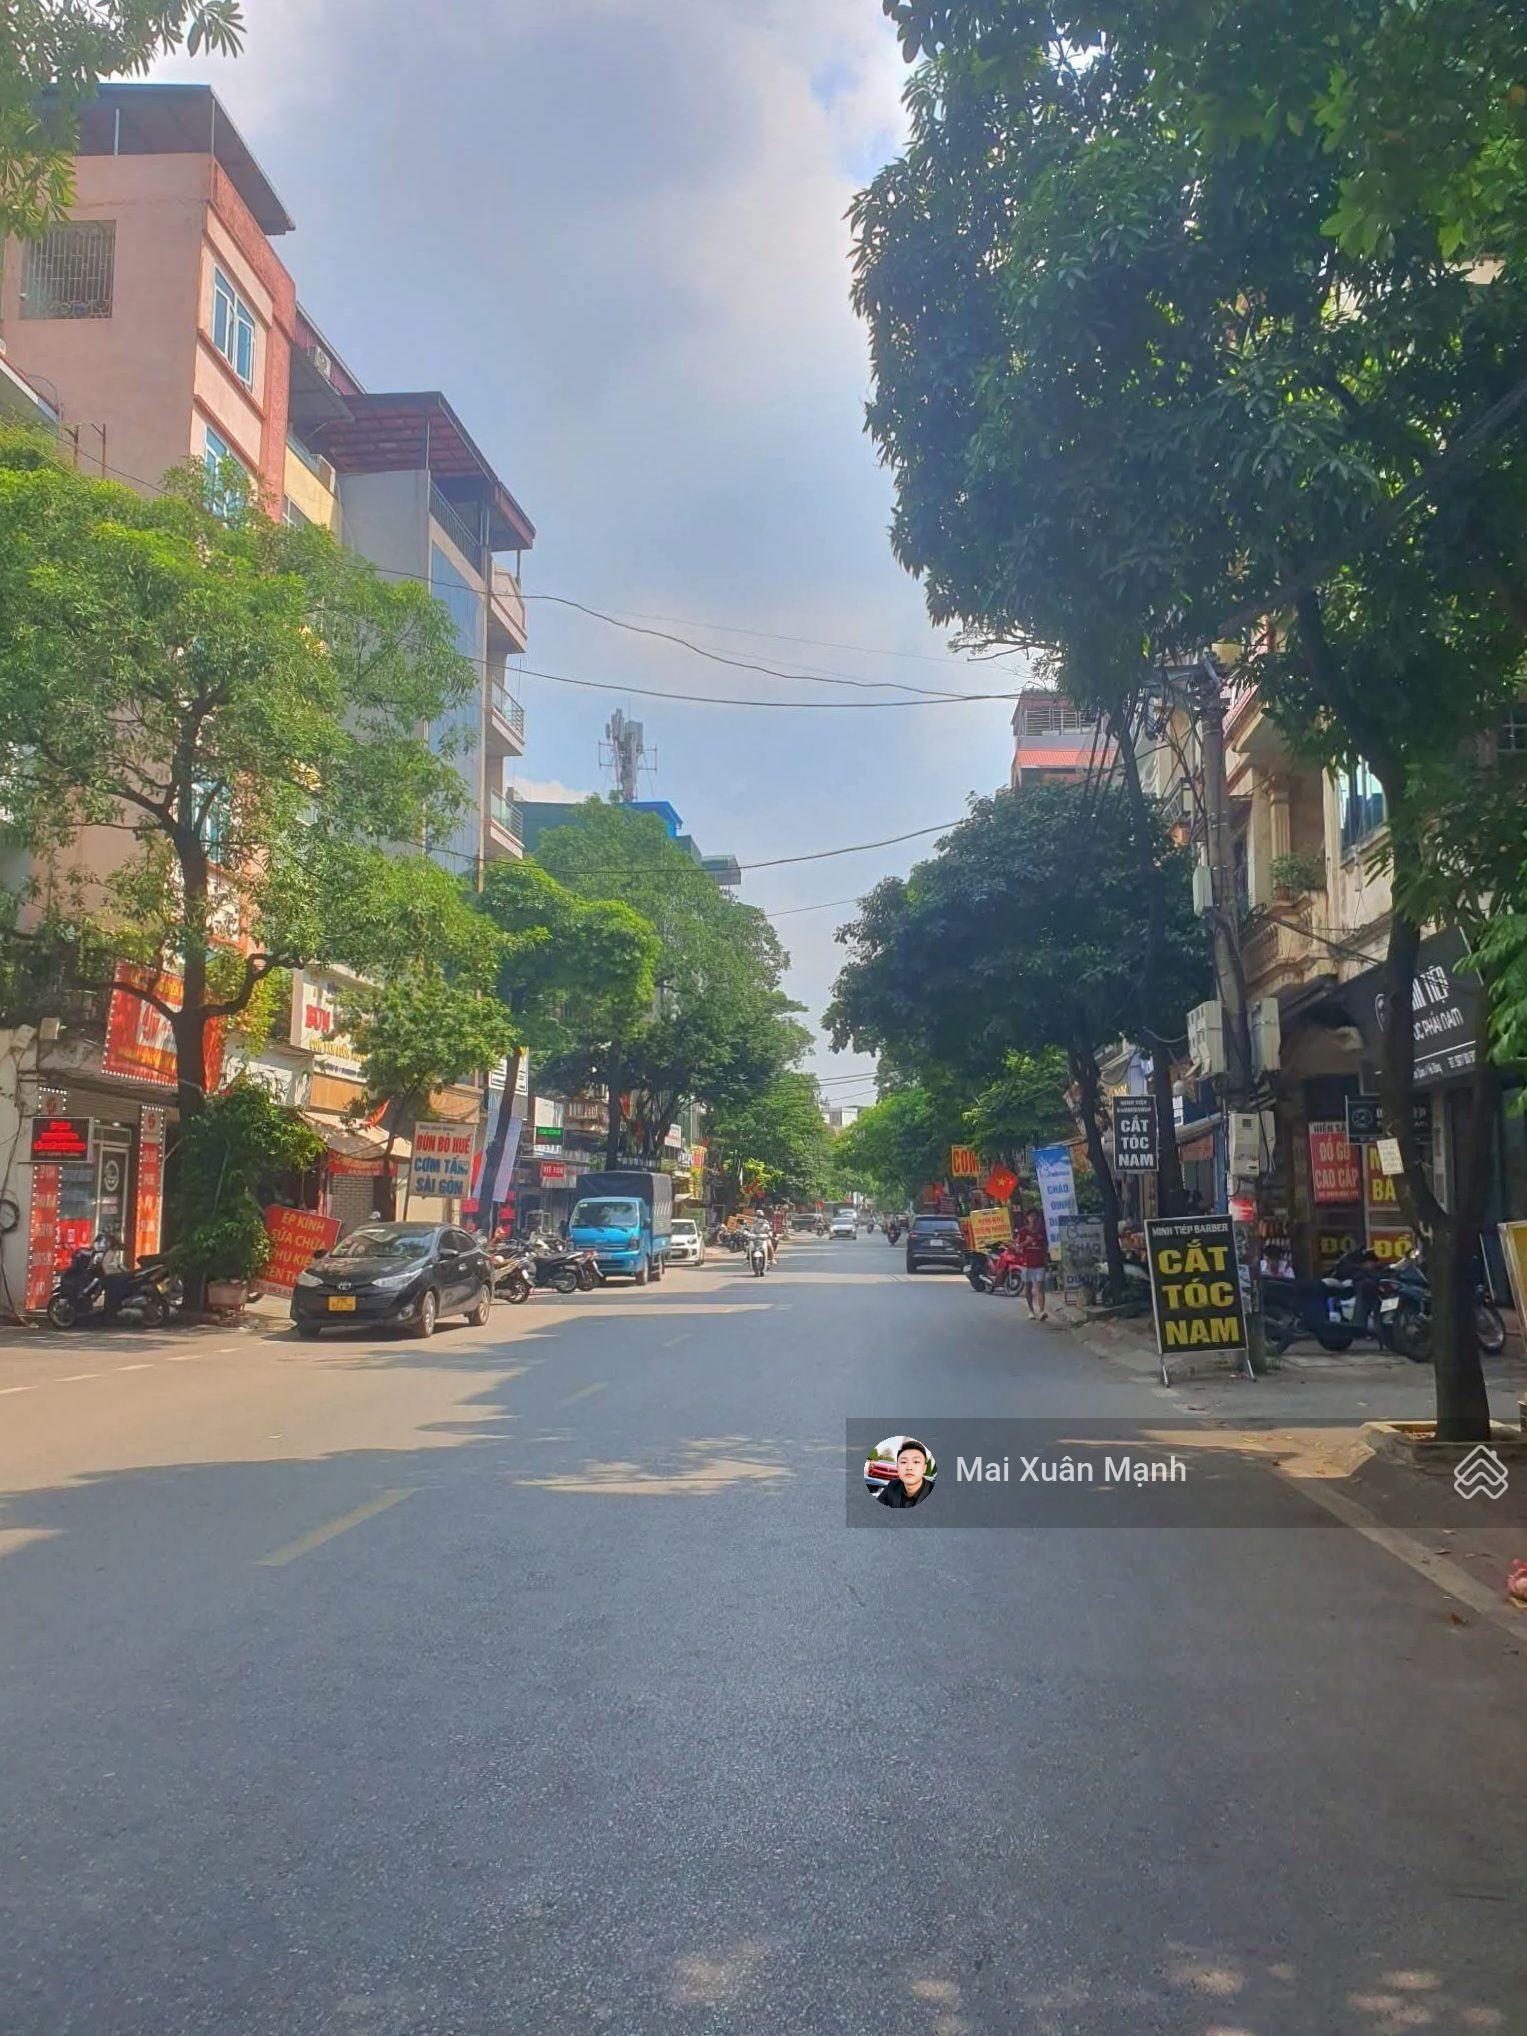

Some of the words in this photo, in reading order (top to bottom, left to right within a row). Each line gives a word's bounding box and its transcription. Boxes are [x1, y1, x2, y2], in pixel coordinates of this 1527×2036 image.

[1120, 1114, 1149, 1133] CẮT
[415, 1131, 436, 1152] BÚN
[452, 1133, 472, 1154] HUẾ
[1120, 1134, 1150, 1150] TÓC
[1118, 1153, 1154, 1167] NAM
[1152, 1226, 1172, 1236] MINH
[1194, 1223, 1229, 1234] BARBER
[1158, 1239, 1228, 1274] CẮT
[1162, 1278, 1235, 1309] TÓC
[1165, 1317, 1240, 1345] NAM
